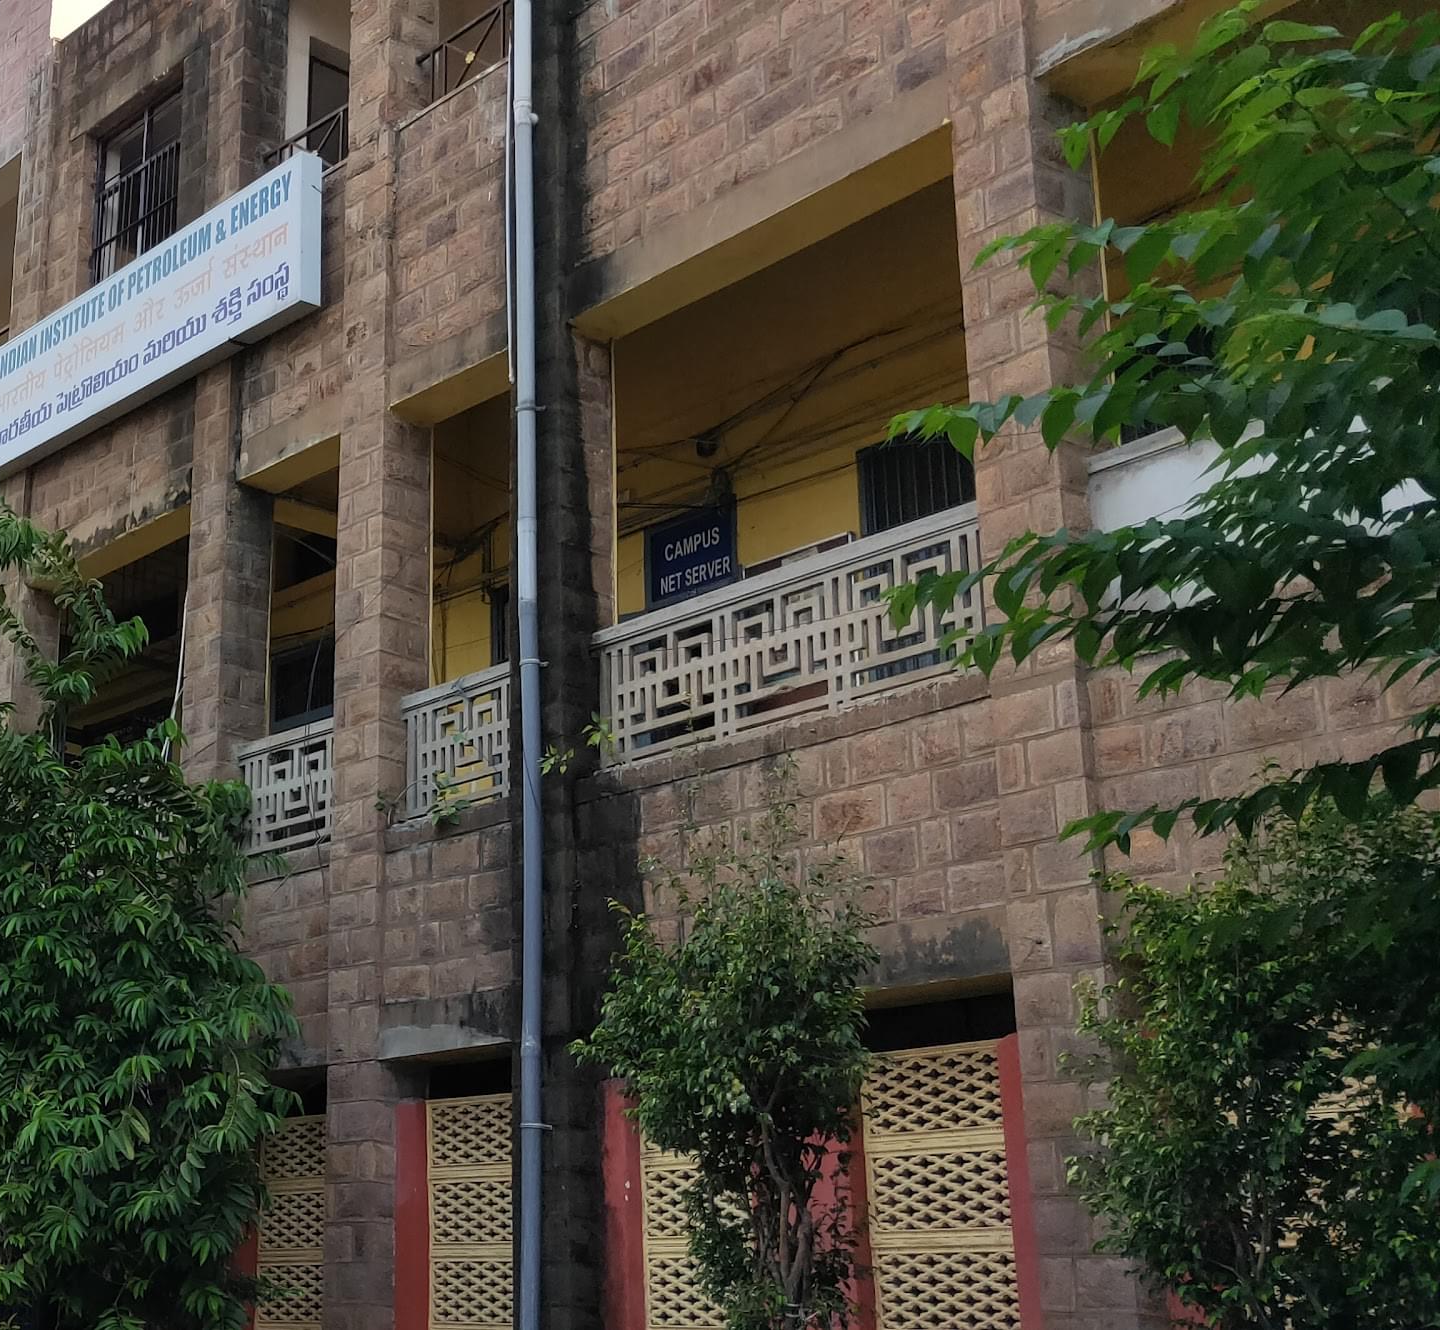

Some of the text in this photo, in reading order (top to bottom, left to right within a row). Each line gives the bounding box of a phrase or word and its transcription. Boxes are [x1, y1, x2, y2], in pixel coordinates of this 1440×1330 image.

[40, 291, 106, 355] INSTITUTE
[108, 279, 125, 313] OF
[127, 222, 212, 300] PETROLEUM
[215, 218, 226, 244] &
[230, 170, 292, 235] ENERGY
[133, 297, 166, 333] और
[174, 256, 214, 311] ऊर्जा
[223, 222, 289, 281] संस्थान
[143, 313, 207, 366] మరియు
[212, 286, 242, 326] శక్తి
[246, 261, 290, 301] సంస్థ
[660, 555, 731, 596] NET SERVER
[664, 527, 720, 561] CAMPUS
